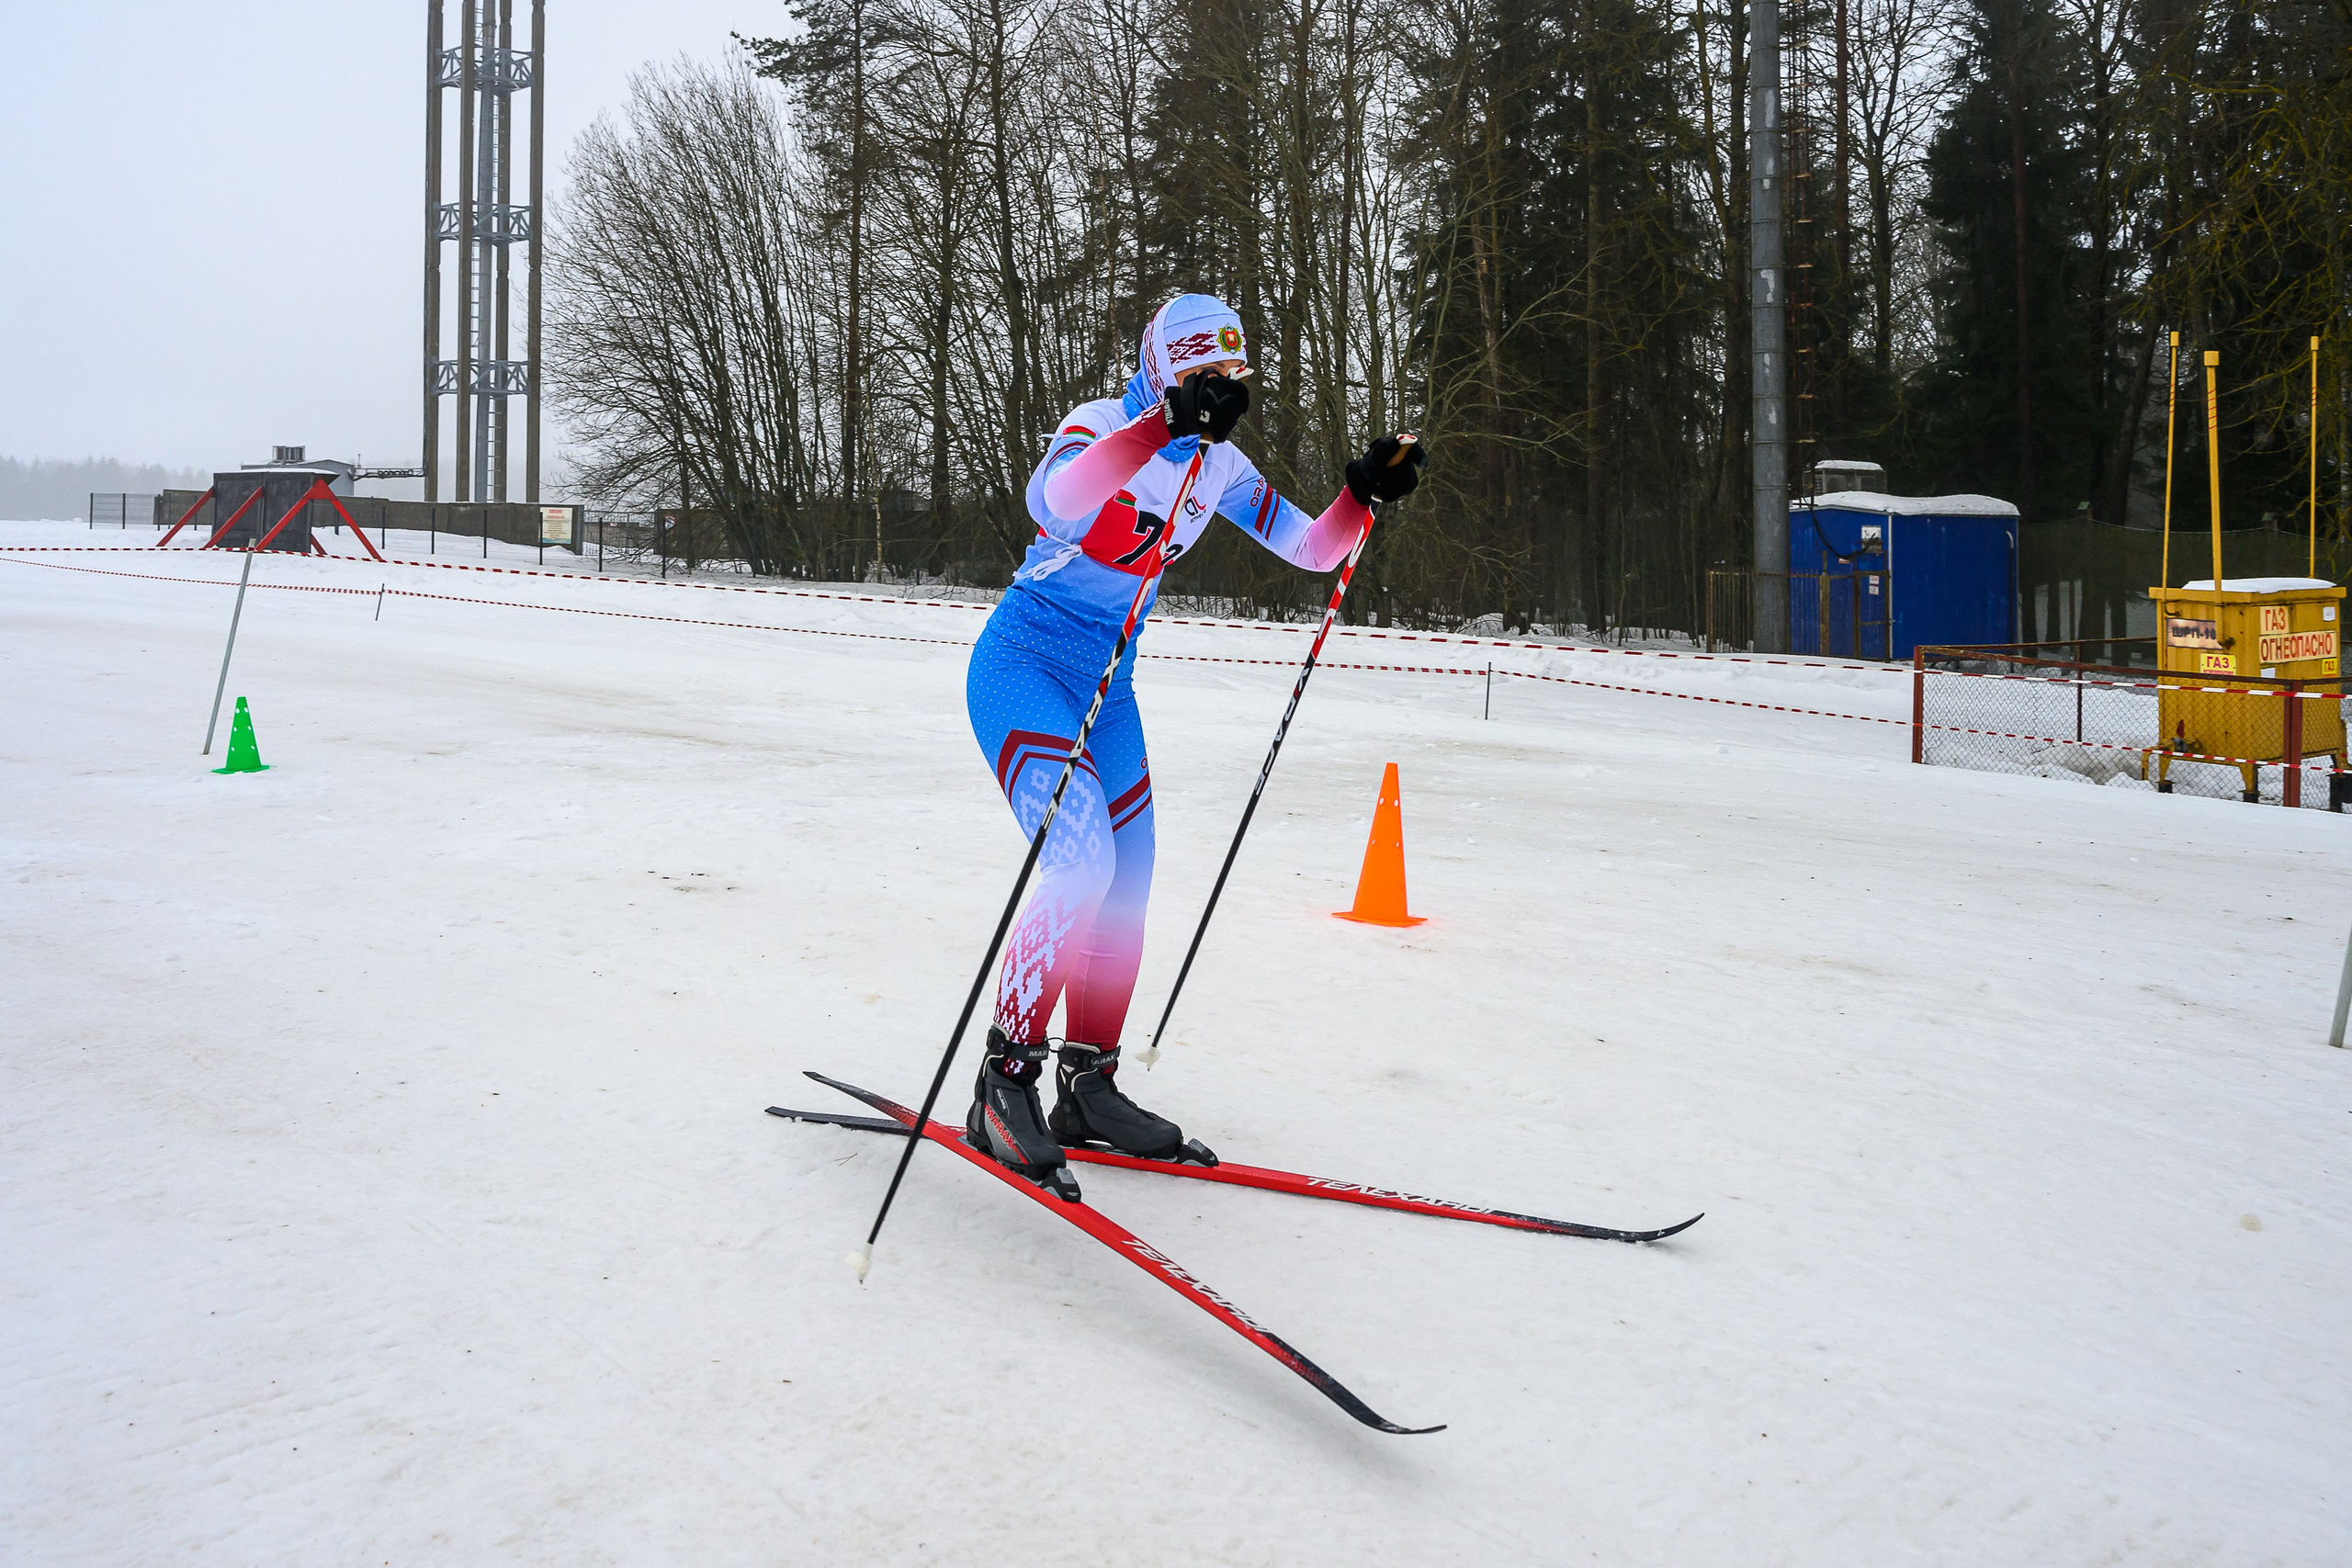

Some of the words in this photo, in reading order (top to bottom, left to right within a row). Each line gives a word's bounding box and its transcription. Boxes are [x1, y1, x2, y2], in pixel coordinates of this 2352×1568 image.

[2265, 608, 2286, 631] ГАЗ
[2261, 633, 2333, 660] ОГНЕОПАСНО
[2207, 656, 2230, 669] ГАЗ
[1091, 1054, 1115, 1066] ARAX
[986, 1104, 1016, 1147] MARAX
